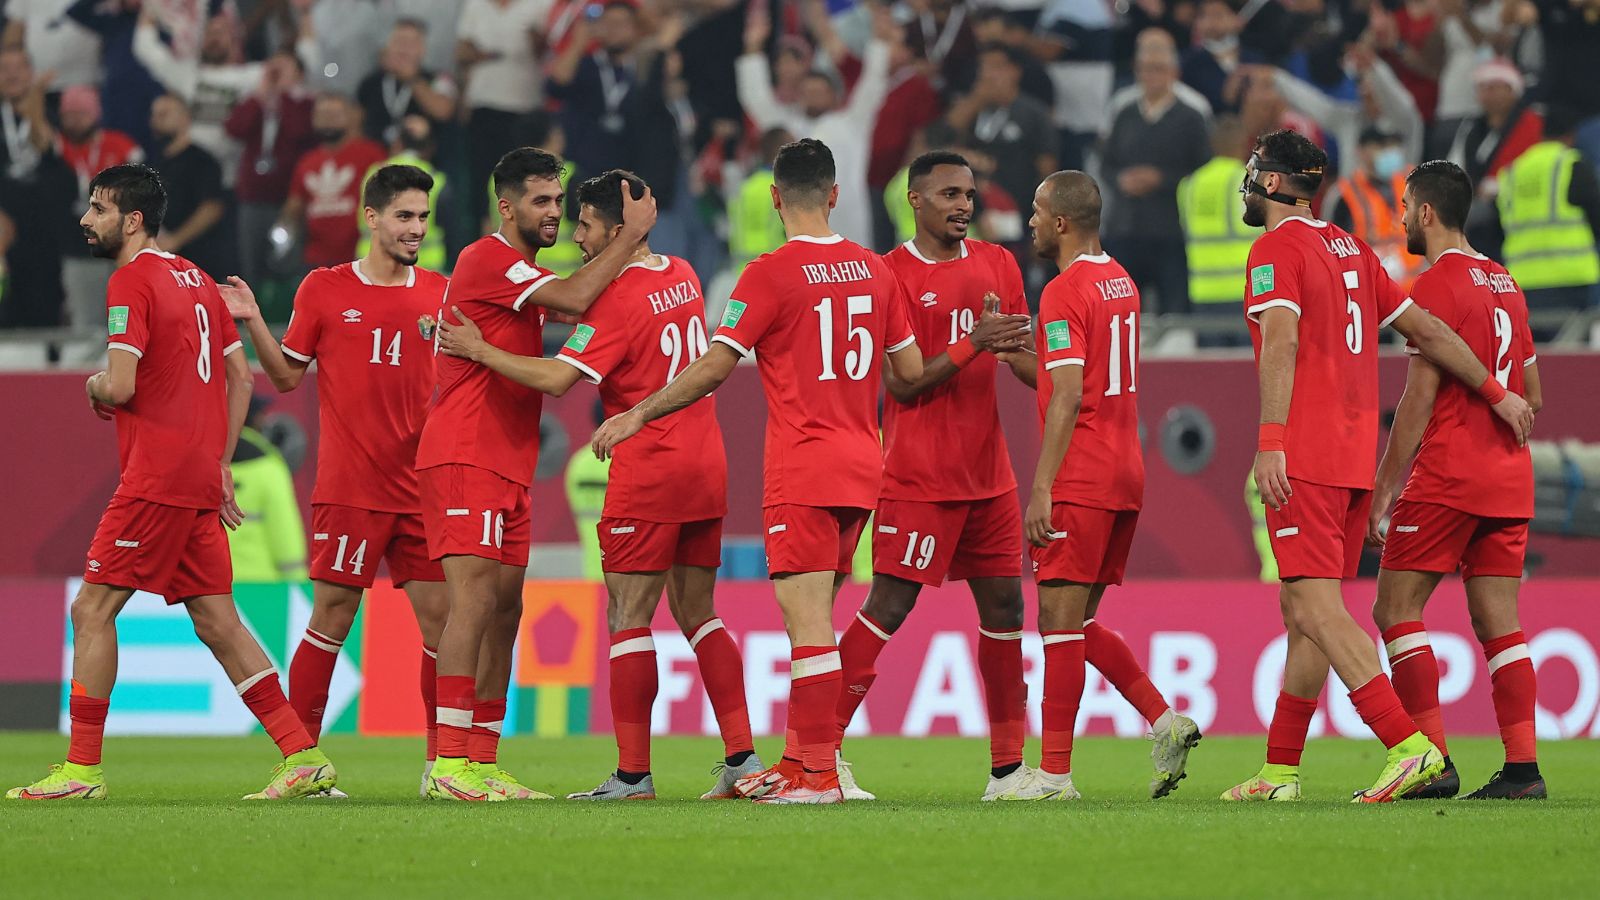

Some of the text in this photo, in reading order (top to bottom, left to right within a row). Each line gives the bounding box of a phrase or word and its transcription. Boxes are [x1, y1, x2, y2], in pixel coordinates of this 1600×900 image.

[802, 260, 873, 285] IBRAHIM
[1095, 277, 1135, 301] YASEEN
[647, 279, 699, 315] HAMZA
[1342, 270, 1363, 355] 5
[194, 303, 212, 384] 8
[813, 295, 874, 381] 15
[947, 308, 974, 344] 19
[369, 328, 402, 366] 14
[660, 315, 711, 388] 20
[1104, 311, 1136, 397] 11
[1493, 306, 1513, 390] 2
[479, 509, 504, 549] 16
[330, 535, 368, 576] 14
[900, 530, 936, 570] 19
[651, 630, 872, 735] FF
